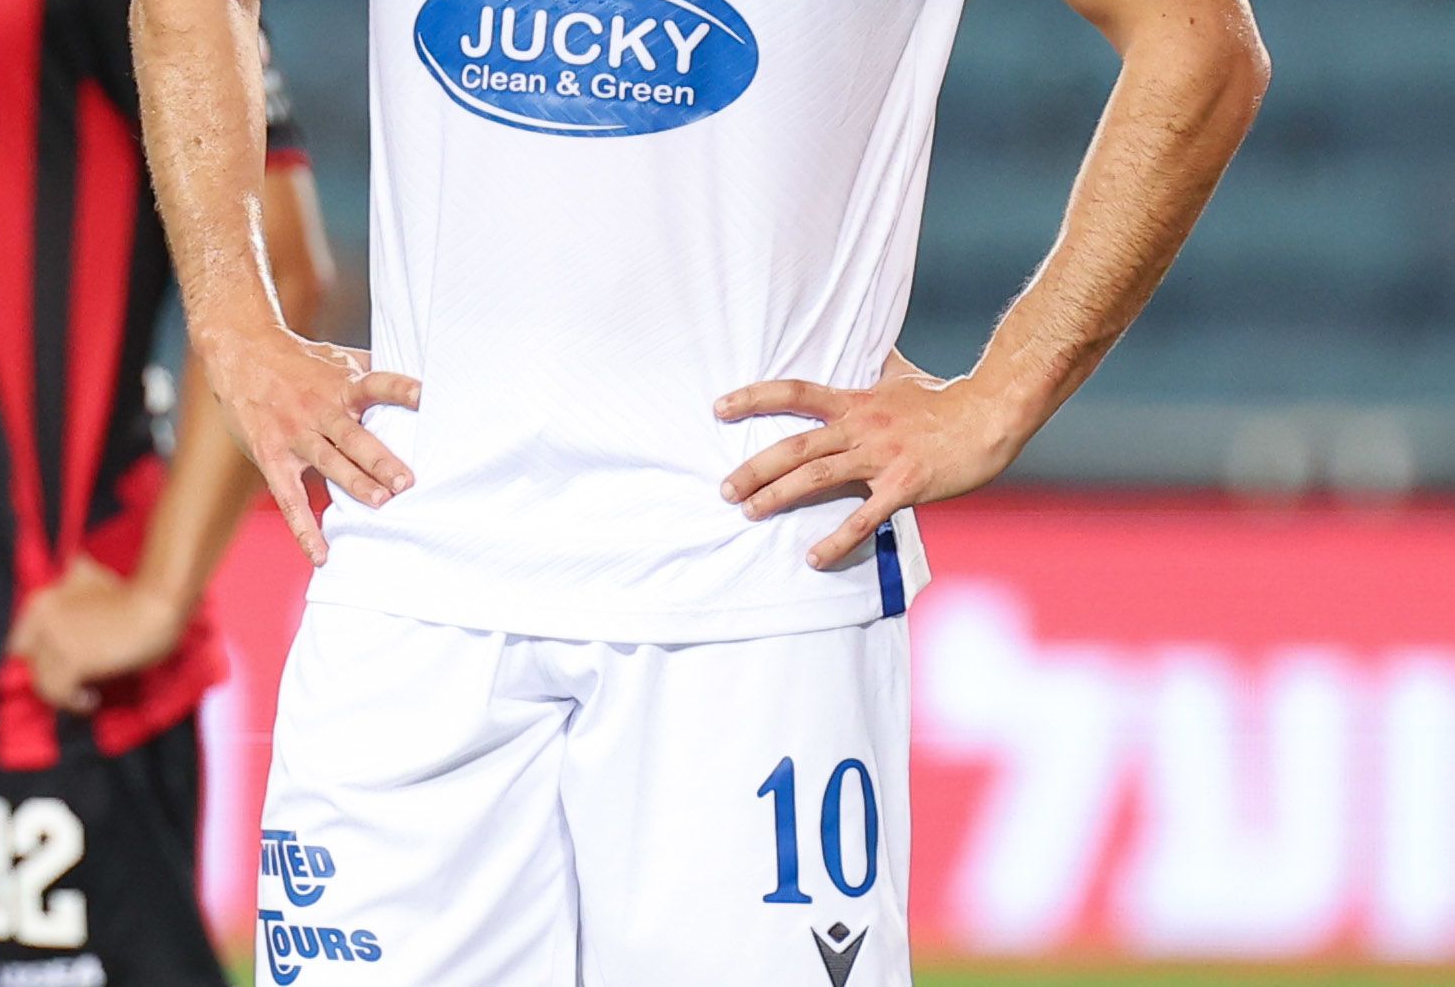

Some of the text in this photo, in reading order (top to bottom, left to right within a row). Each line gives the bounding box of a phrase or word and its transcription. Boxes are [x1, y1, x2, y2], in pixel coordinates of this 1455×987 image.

[459, 6, 711, 75] JUCKY
[460, 63, 695, 106] Clean & Green
[757, 756, 878, 905] 10
[257, 908, 383, 987] TOURS
